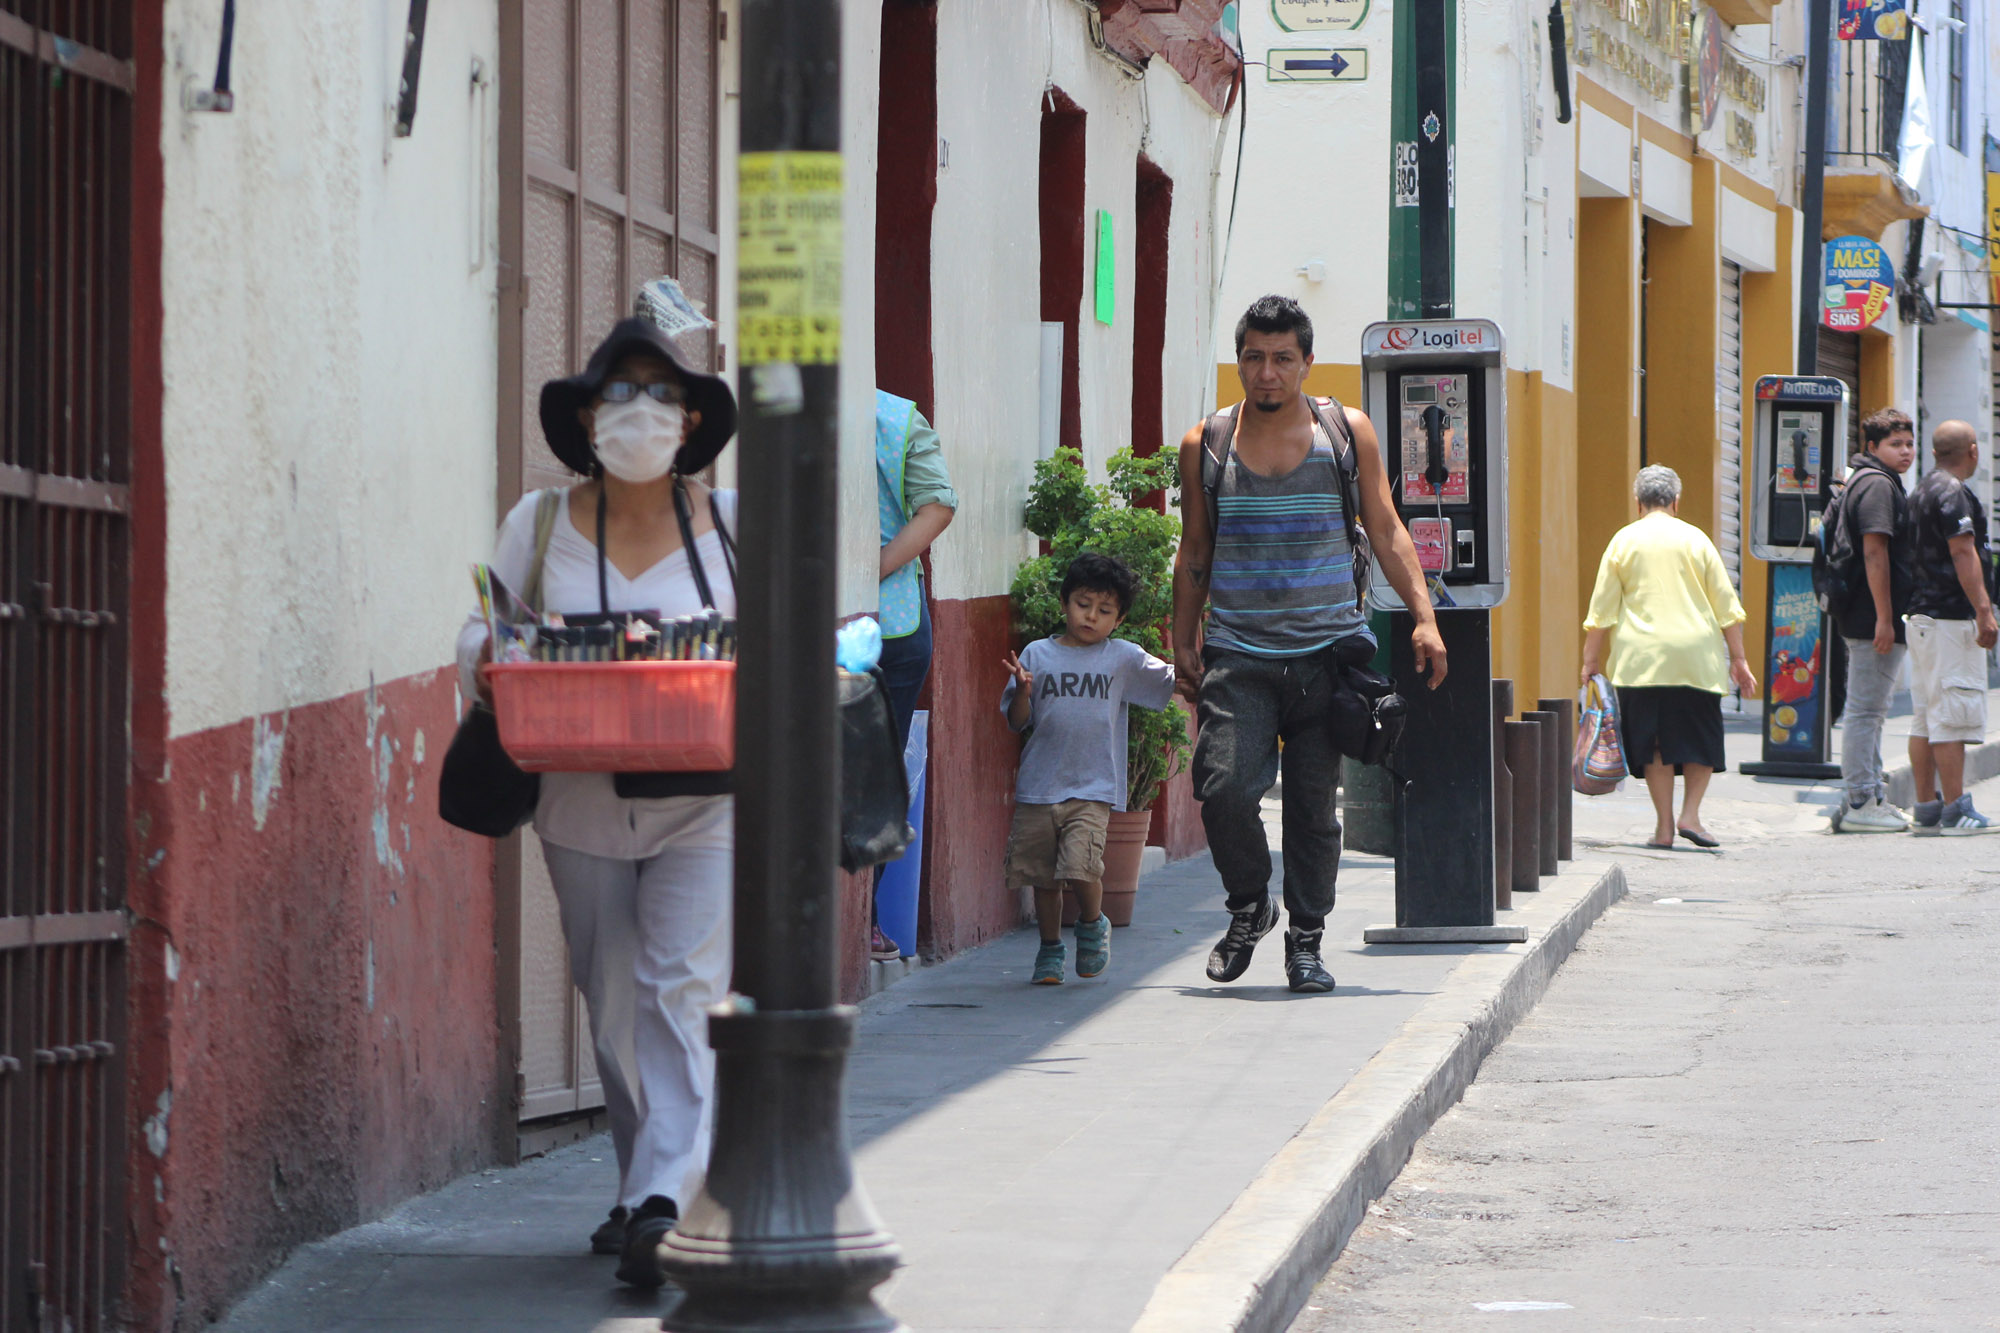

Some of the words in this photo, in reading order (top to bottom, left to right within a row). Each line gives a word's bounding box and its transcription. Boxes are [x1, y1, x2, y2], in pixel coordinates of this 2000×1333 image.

[1833, 248, 1880, 268] MÁS!
[1838, 268, 1880, 278] DOMINGOS
[1829, 313, 1860, 326] SMS
[1423, 328, 1482, 349] Logitel
[1783, 383, 1841, 396] MONEDAS
[1775, 620, 1806, 638] mig
[1041, 672, 1114, 700] ARMY
